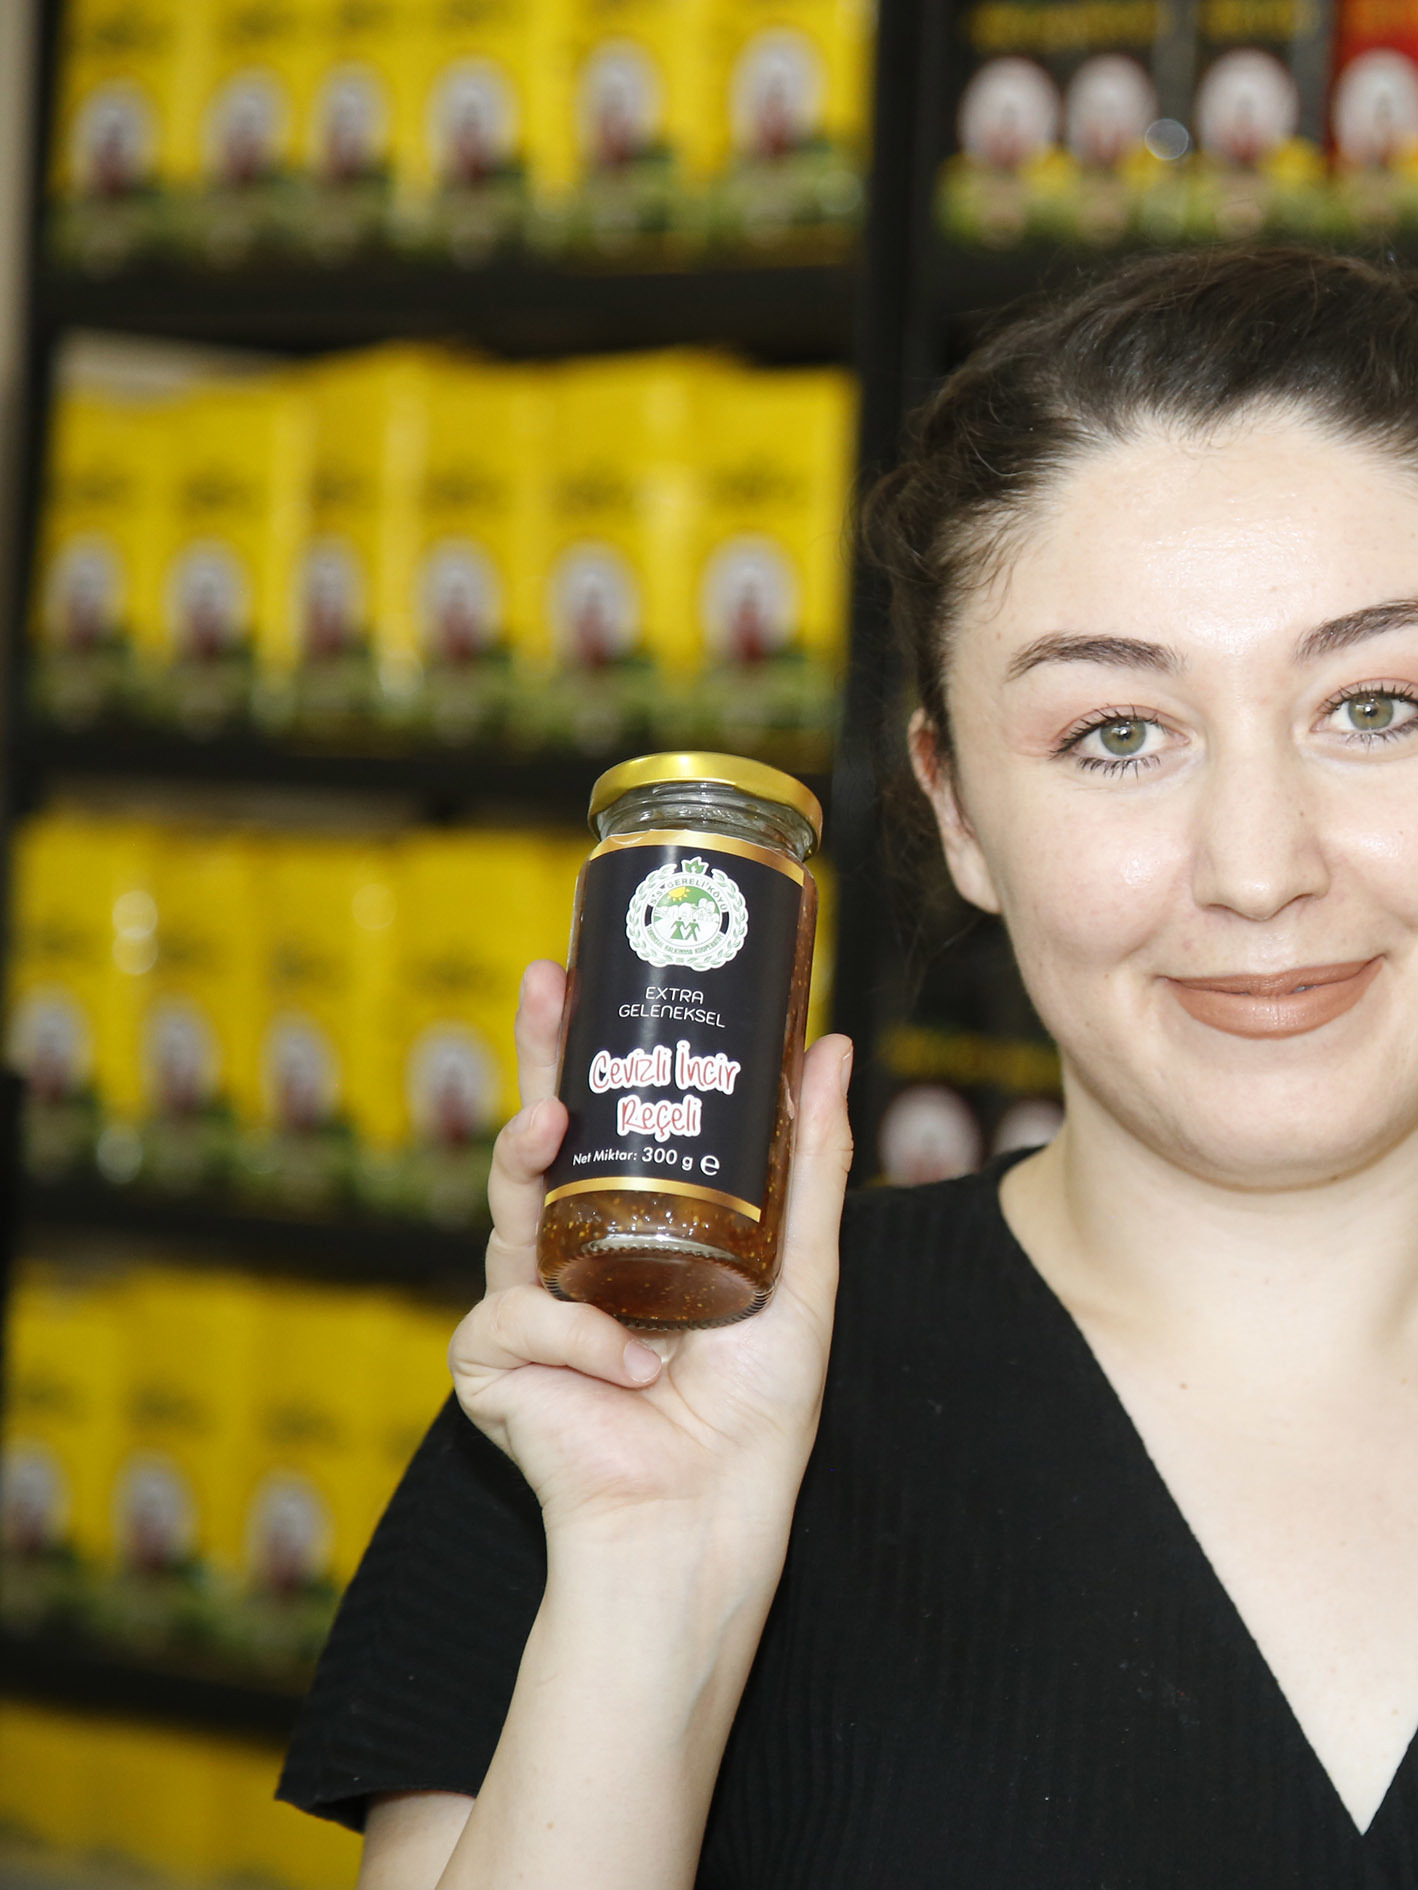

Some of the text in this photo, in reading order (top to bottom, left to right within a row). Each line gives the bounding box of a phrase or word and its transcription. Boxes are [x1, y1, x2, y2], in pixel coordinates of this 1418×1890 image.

[645, 986, 704, 1005] EXTRA
[618, 1003, 726, 1028] GELENEKSEL
[591, 1042, 738, 1091] Cevizli İncir
[620, 1097, 700, 1139] Reçeli
[572, 1153, 592, 1166] Net
[593, 1148, 638, 1163] Miktar:
[641, 1146, 678, 1165] 300
[681, 1156, 694, 1171] g
